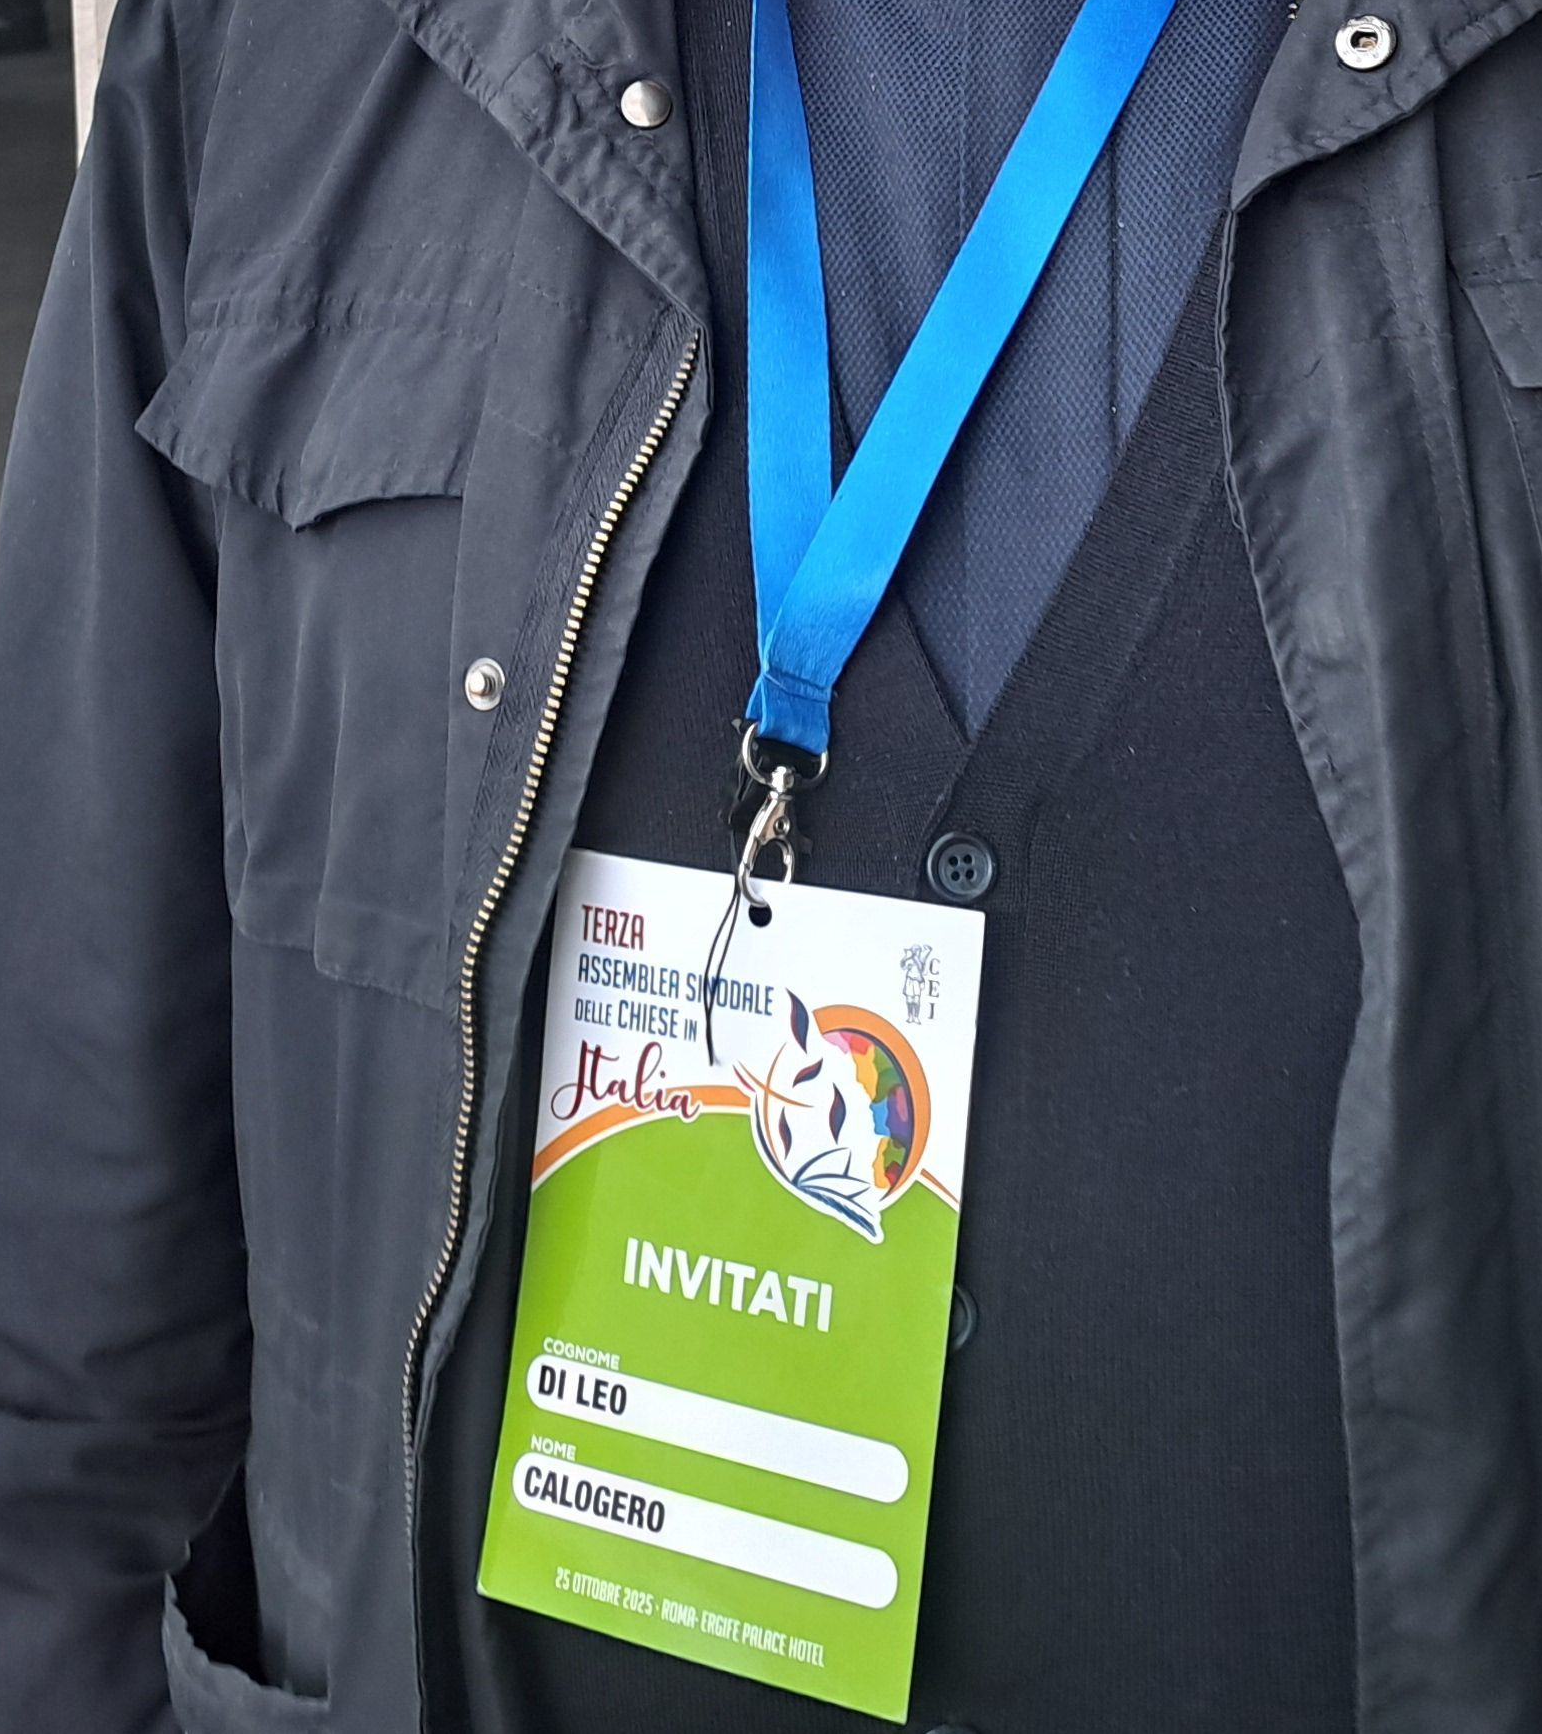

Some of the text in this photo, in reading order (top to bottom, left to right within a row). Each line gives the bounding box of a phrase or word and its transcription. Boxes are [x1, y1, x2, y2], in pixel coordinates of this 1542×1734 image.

[581, 904, 645, 951] TERZA
[578, 953, 680, 999] ASSEMBLEA
[575, 998, 698, 1043] DELLE CHIESE IN
[551, 1039, 701, 1120] Italia
[623, 1237, 834, 1333] INVITATI
[543, 1337, 621, 1371] COGNOME
[538, 1365, 627, 1416] DI LEO
[530, 1434, 577, 1462] NOME
[524, 1466, 666, 1534] CALOGERO
[555, 1567, 571, 1591] 25
[572, 1572, 622, 1606] OTTOBRE
[623, 1587, 654, 1617] 2025
[700, 1612, 741, 1643] ERGIFE
[741, 1623, 787, 1657] PALACE
[788, 1636, 825, 1668] HOTEL
